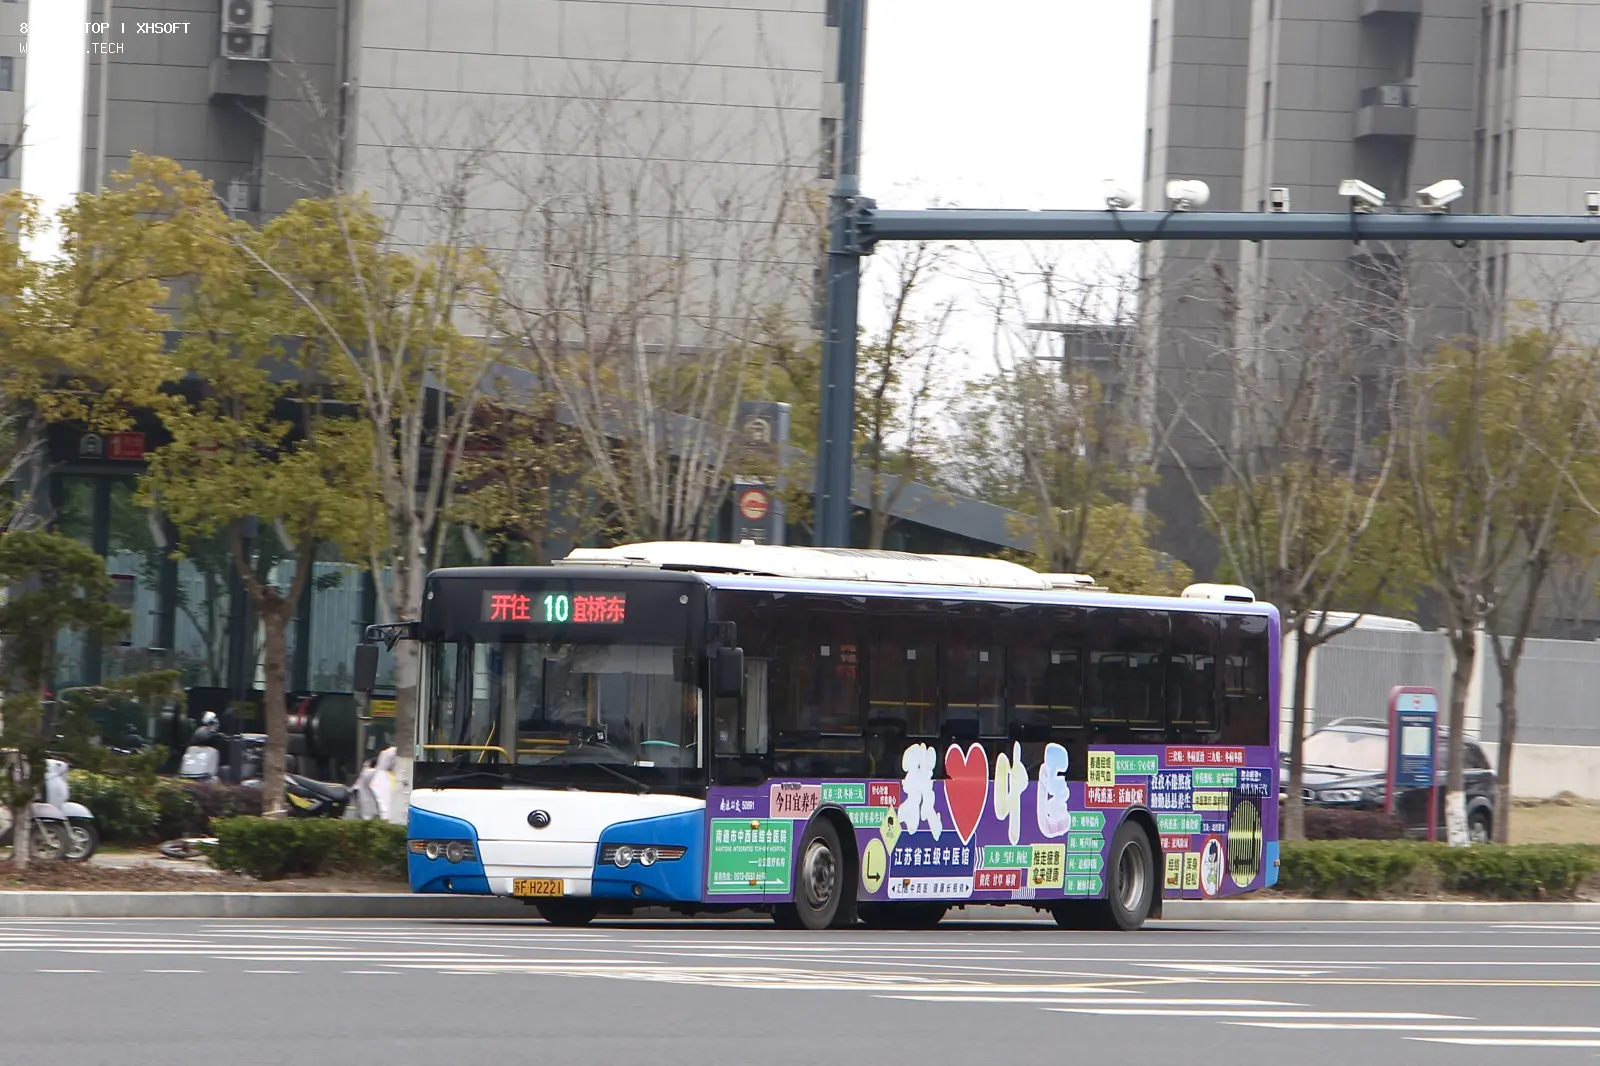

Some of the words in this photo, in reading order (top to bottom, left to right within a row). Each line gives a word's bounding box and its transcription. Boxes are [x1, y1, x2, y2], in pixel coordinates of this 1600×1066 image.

[490, 593, 531, 621] 开往
[544, 594, 570, 622] 10
[775, 792, 819, 813] 今日宜养生
[715, 829, 787, 844] 南通市中西医结合医院
[894, 847, 970, 867] 江苏省五级中医馆
